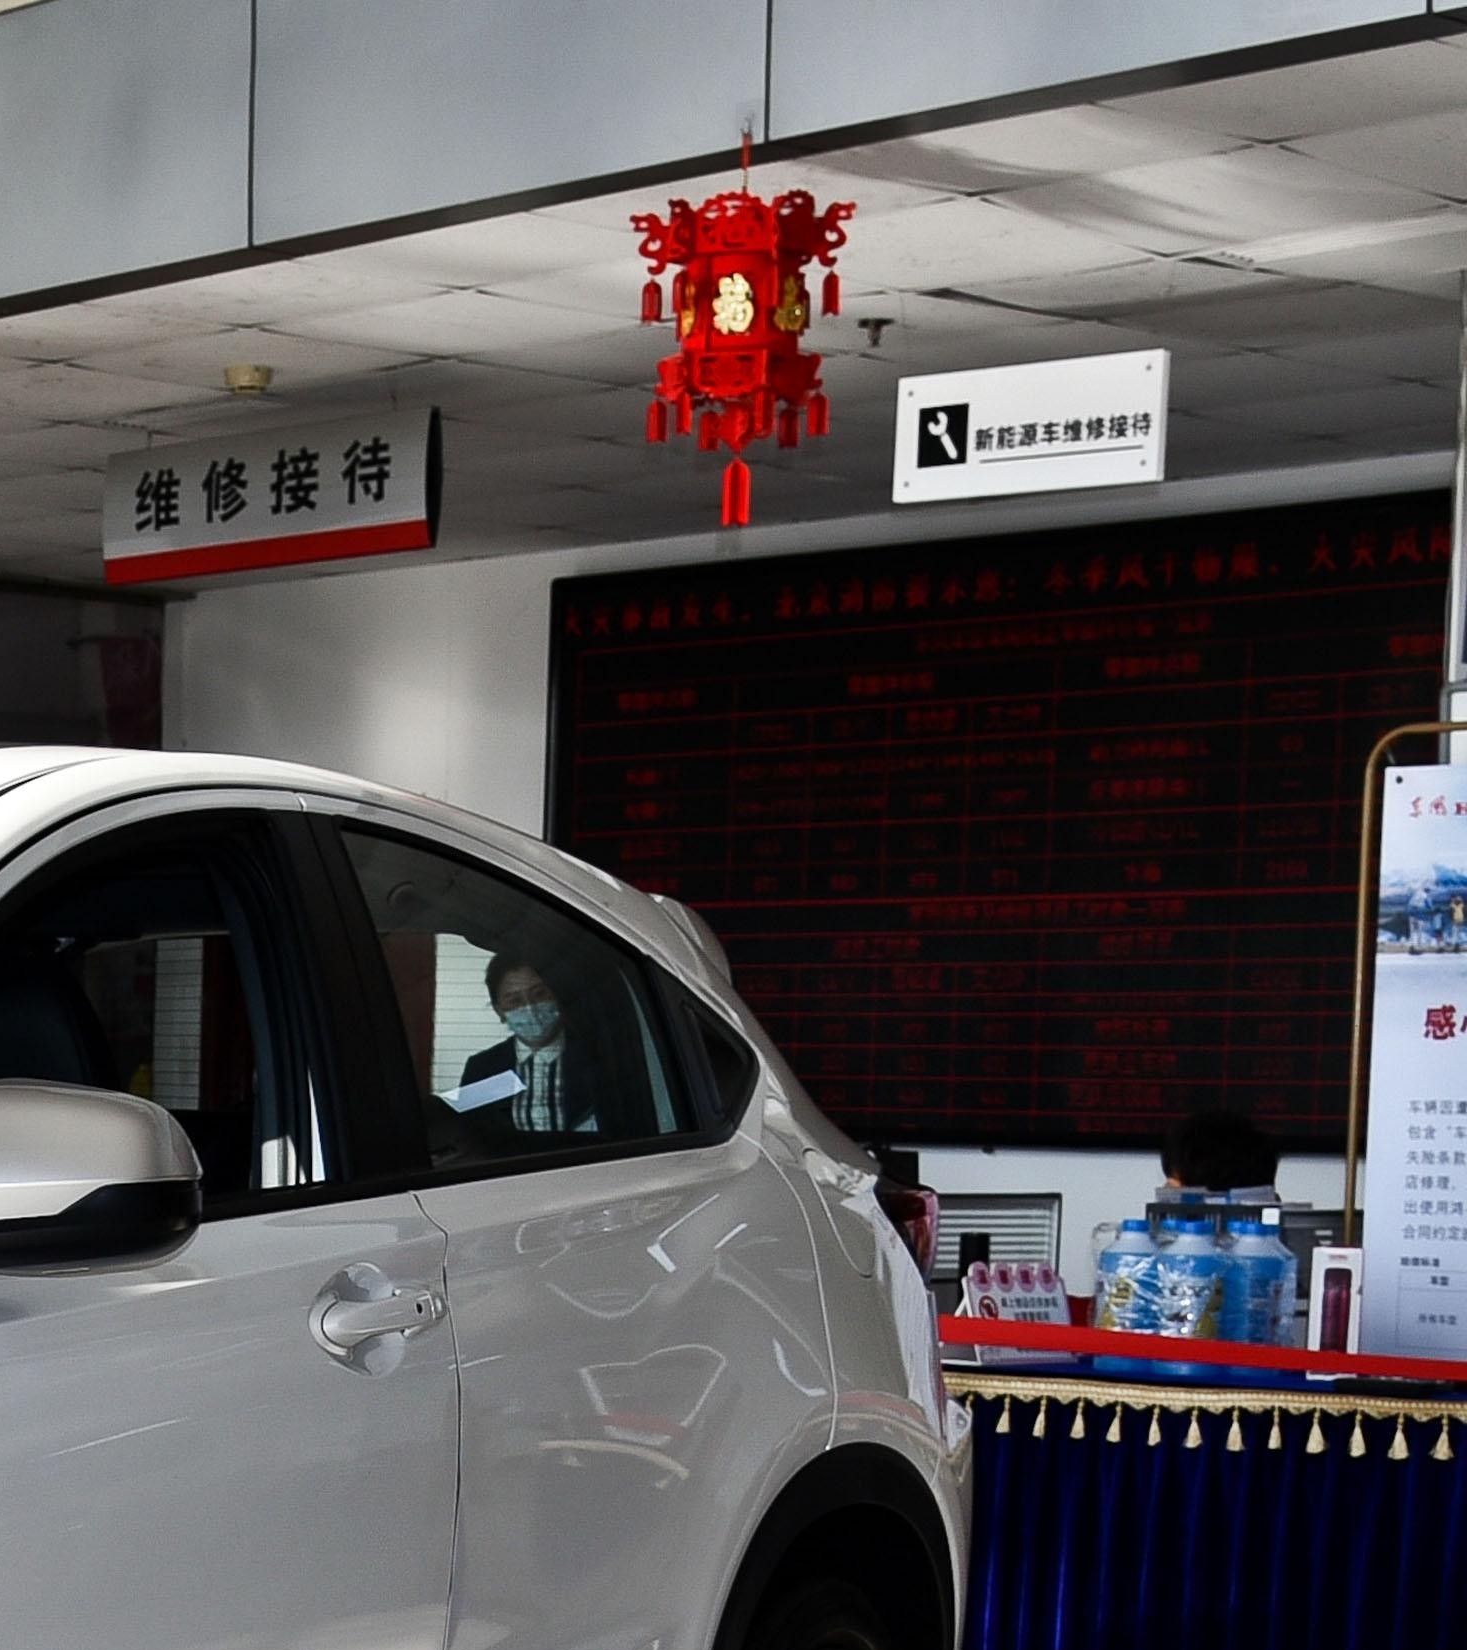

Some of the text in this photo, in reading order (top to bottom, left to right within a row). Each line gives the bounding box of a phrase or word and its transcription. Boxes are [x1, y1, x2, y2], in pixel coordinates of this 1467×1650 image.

[974, 410, 1152, 454] 新能源车维修接待
[134, 436, 392, 534] 维修接待
